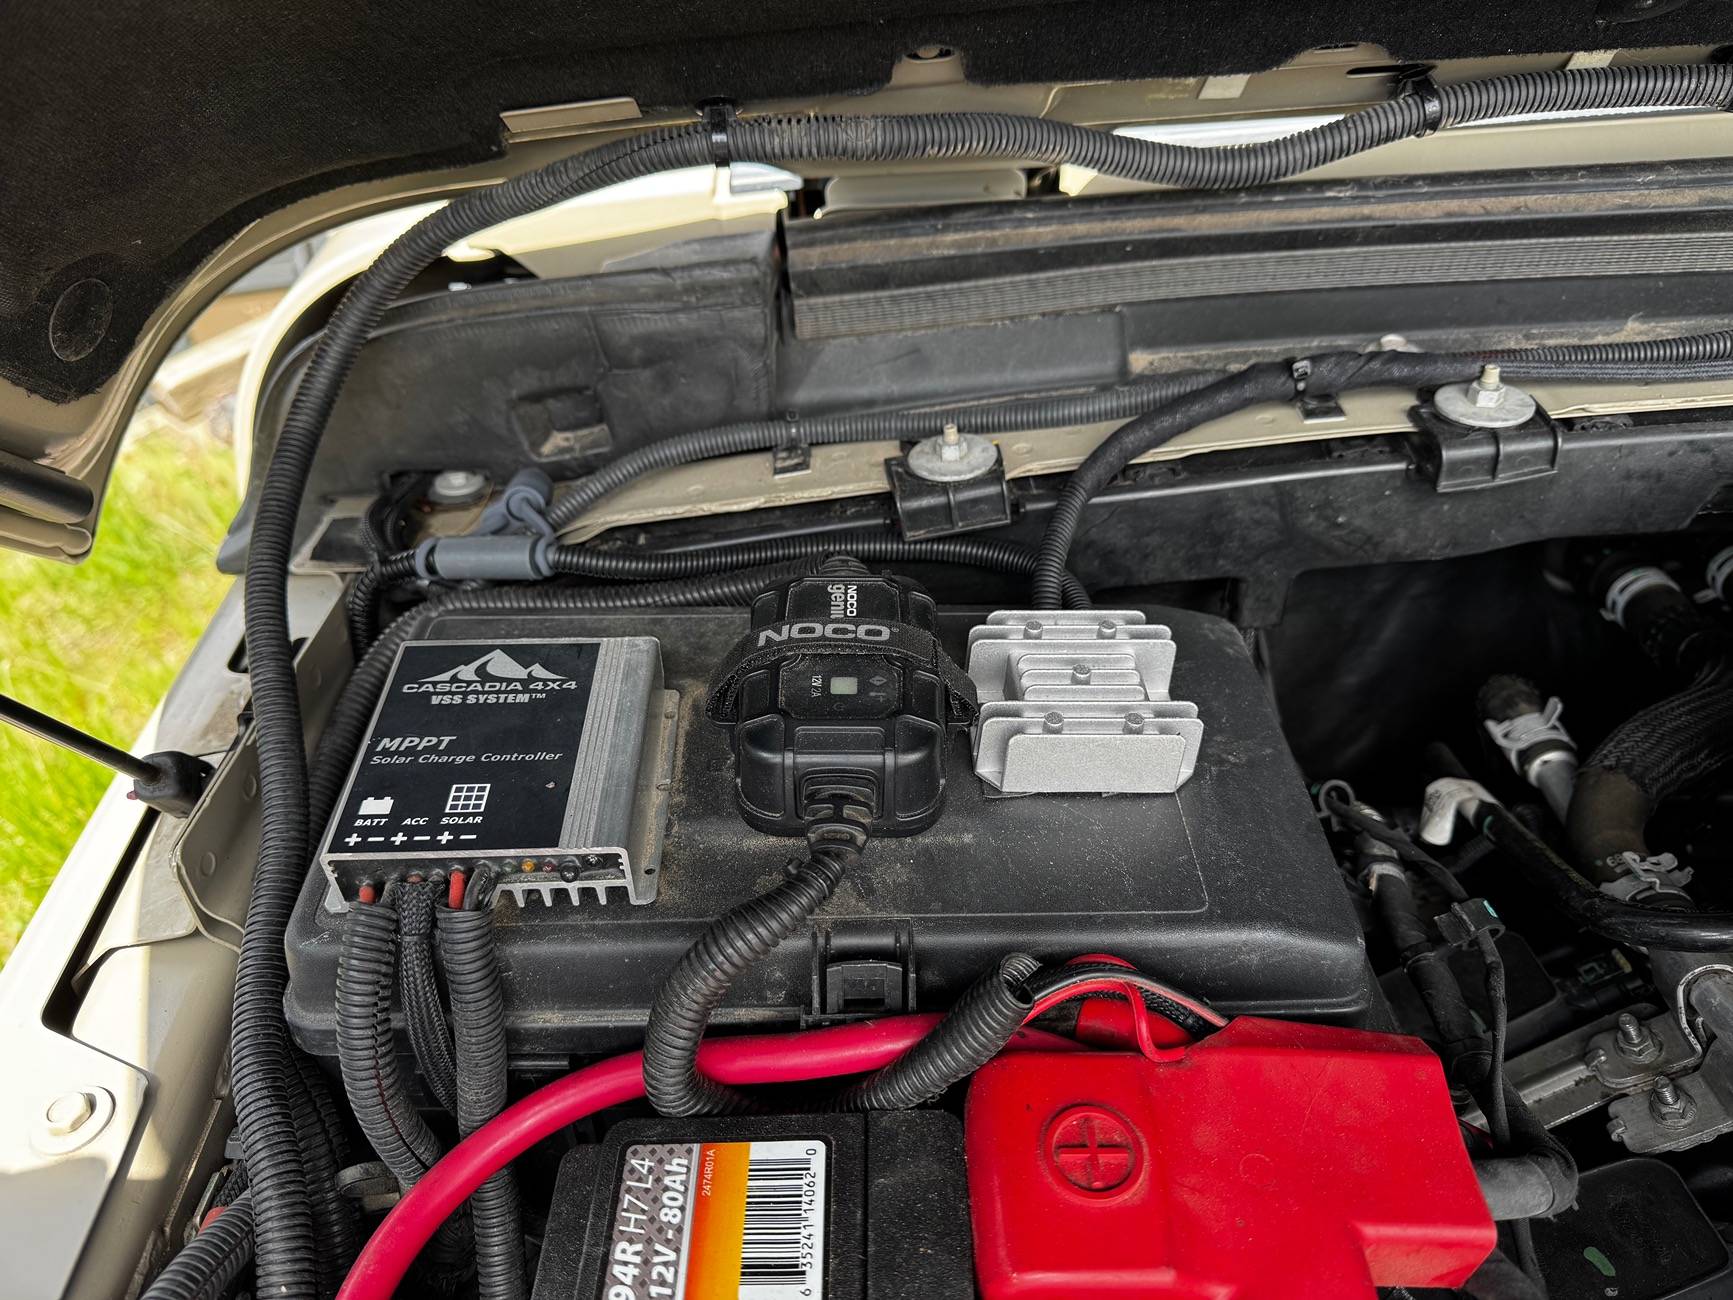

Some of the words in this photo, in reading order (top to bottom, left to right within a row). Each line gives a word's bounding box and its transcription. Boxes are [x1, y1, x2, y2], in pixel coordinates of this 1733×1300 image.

[846, 585, 858, 617] NOCO
[402, 681, 524, 693] CASCADIA
[430, 694, 463, 705] VSS
[375, 736, 458, 751] MPPT
[370, 755, 415, 765] Solar
[418, 754, 476, 765] Charge
[480, 752, 563, 762] Controller
[353, 818, 389, 827] BATT
[401, 817, 429, 825] ACC
[439, 816, 484, 825] SOLAR
[805, 1148, 817, 1156] 0
[701, 1148, 716, 1197] 2474R01A
[660, 1156, 689, 1225] 80Ah
[803, 1171, 816, 1214] 14062
[800, 1224, 815, 1269] 35241
[608, 1241, 643, 1300] 94R
[649, 1243, 677, 1298] 12V
[800, 1288, 812, 1297] 6
